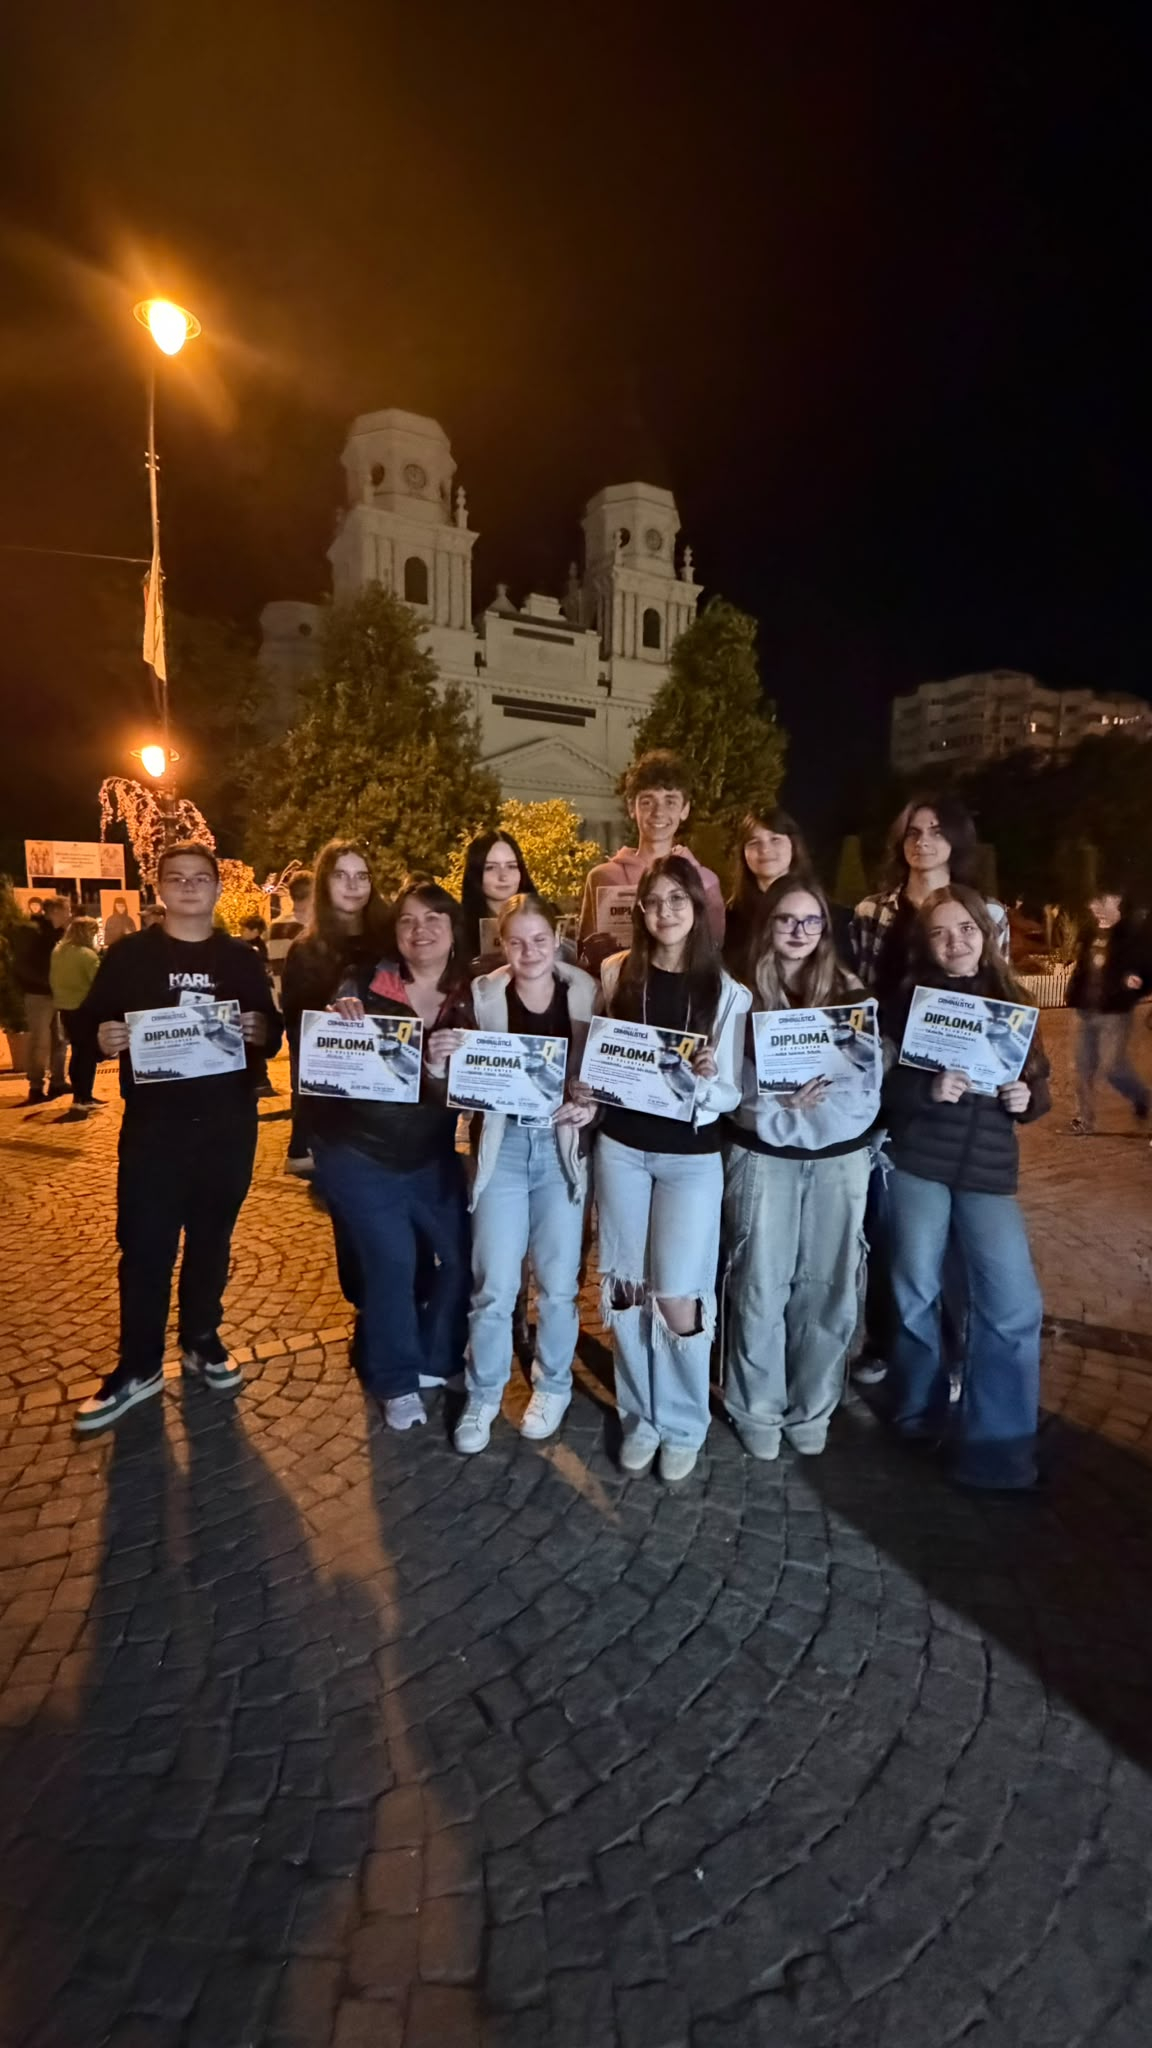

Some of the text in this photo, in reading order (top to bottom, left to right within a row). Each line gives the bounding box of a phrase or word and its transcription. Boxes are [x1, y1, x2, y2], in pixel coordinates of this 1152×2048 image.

[169, 973, 215, 987] KARL
[924, 1013, 982, 1033] DIPLOMĂ
[145, 1025, 200, 1041] DIPLOMĂ
[771, 1031, 829, 1046] DIPLOMĂ
[317, 1037, 374, 1051] DIPLOMĂ
[601, 1043, 655, 1064] DIPLOMĂ
[466, 1054, 521, 1069] DIPLOMĂ
